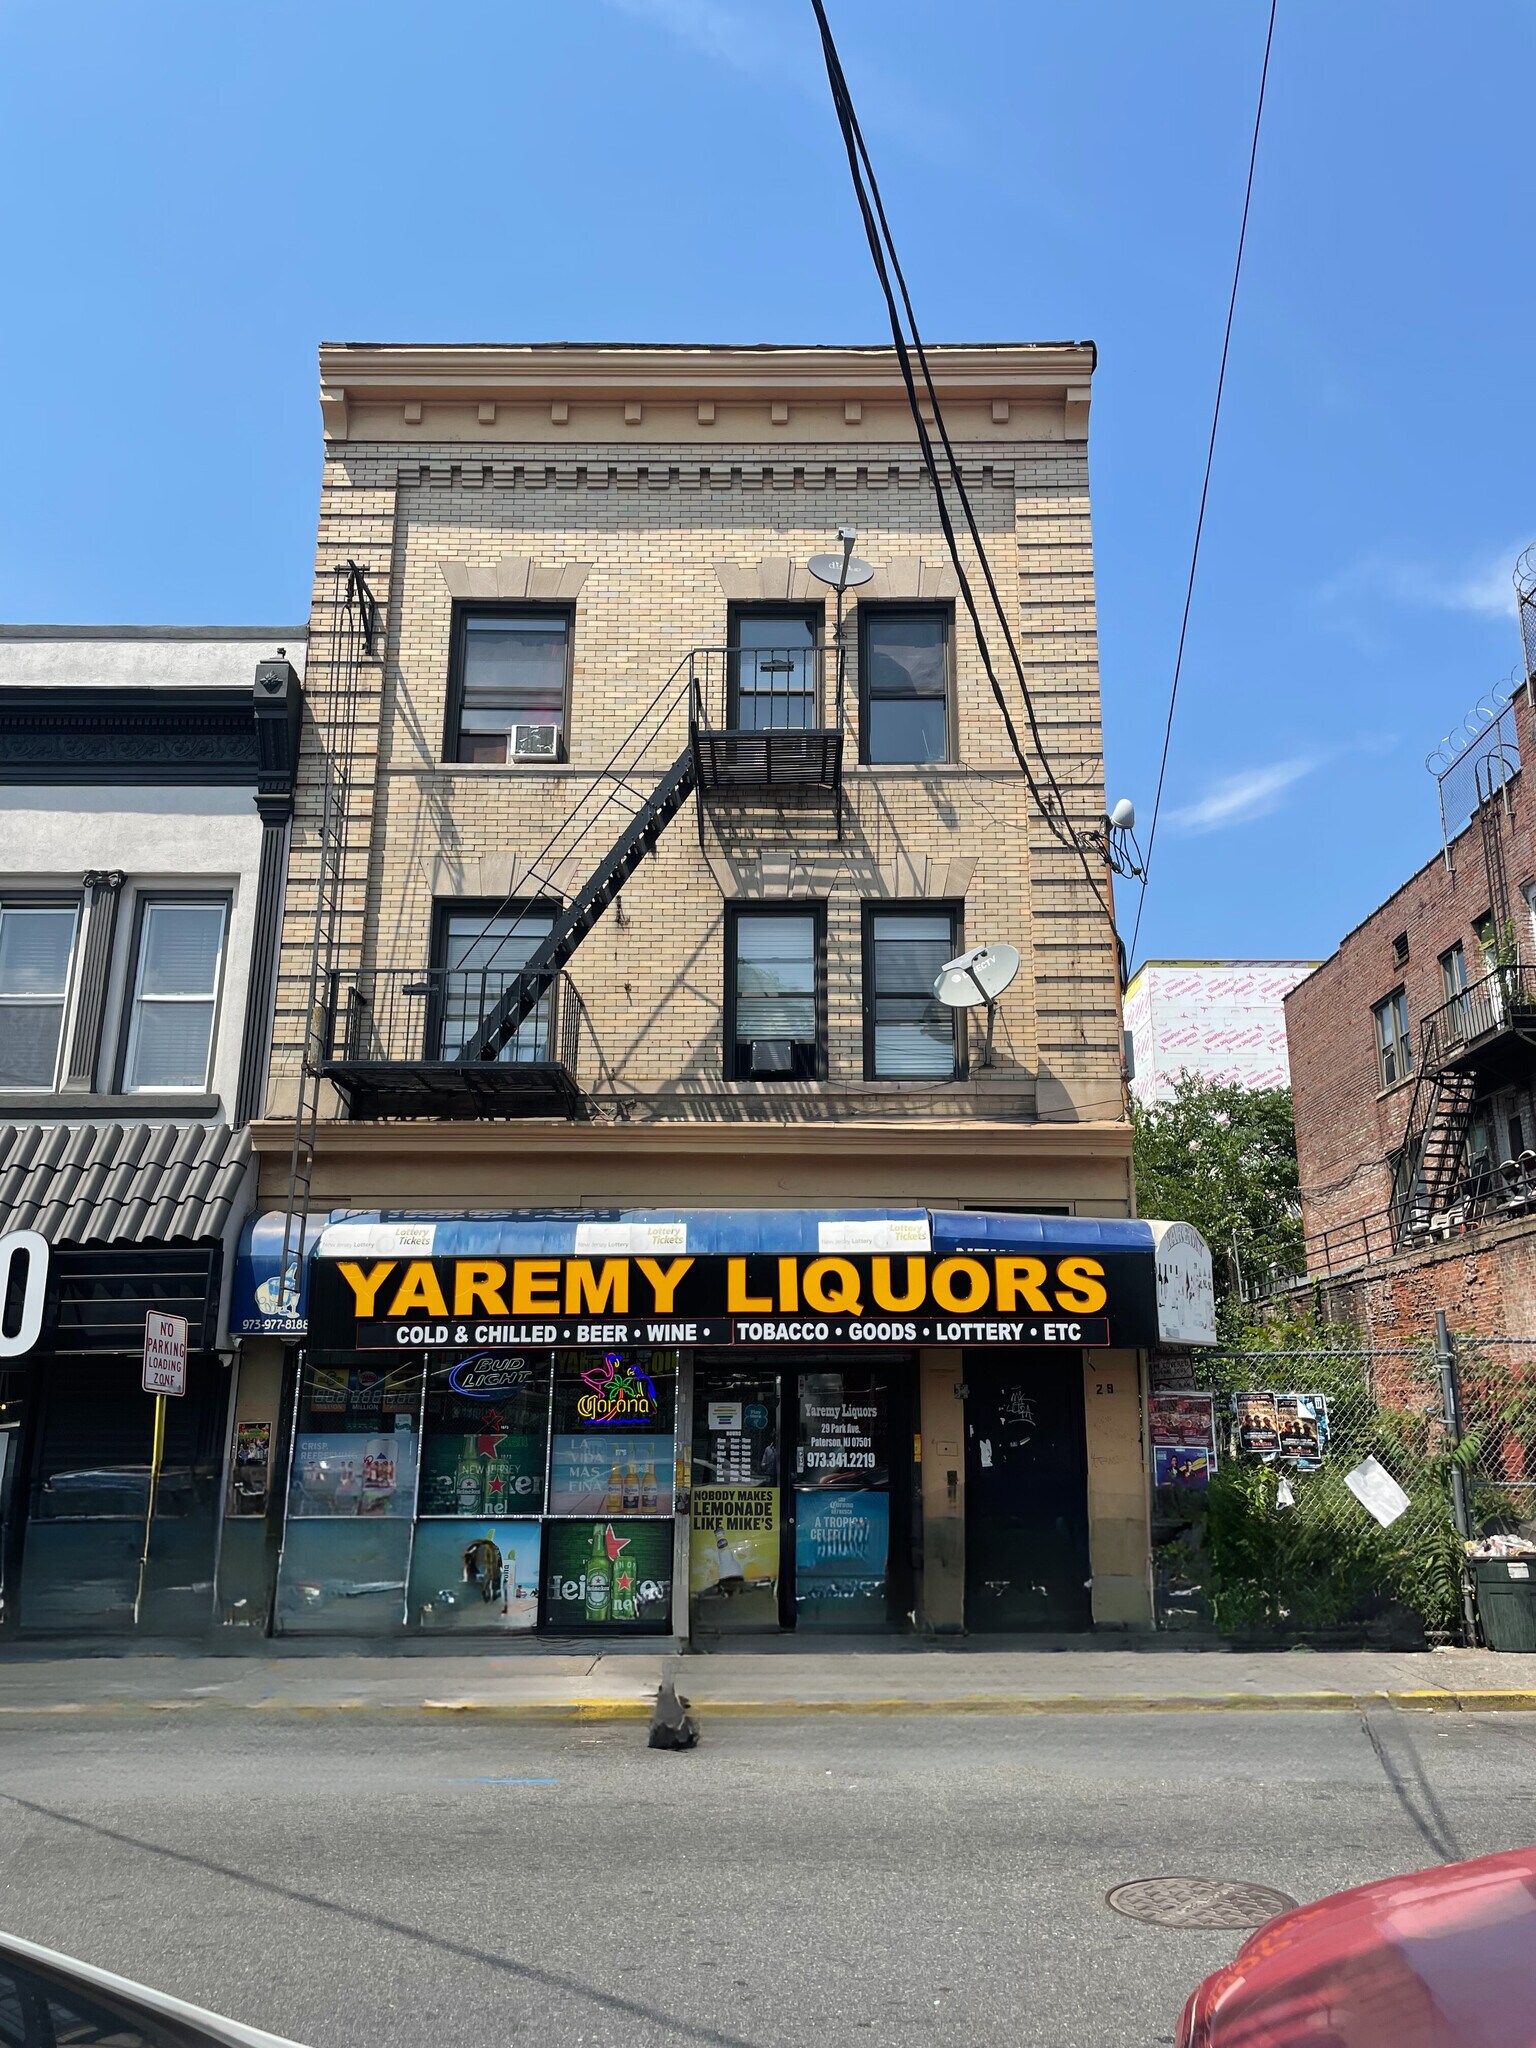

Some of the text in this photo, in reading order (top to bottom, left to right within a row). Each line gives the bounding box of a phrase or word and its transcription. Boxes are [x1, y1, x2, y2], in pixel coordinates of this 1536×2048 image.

[962, 955, 996, 980] DECTV
[396, 1228, 428, 1237] Lottery
[648, 1228, 680, 1236] Lottery
[890, 1224, 922, 1234] Lottery
[896, 1232, 926, 1240] Tickets
[399, 1236, 430, 1245] Tickets
[652, 1236, 683, 1244] Tickets
[335, 1257, 696, 1317] YAREMY
[727, 1255, 1108, 1317] LIQUORS
[160, 1321, 174, 1338] NO
[396, 1323, 697, 1344] COLD & CHILLED BEER WINE
[737, 1323, 1082, 1341] TOBACCO GOODS LOTTERY ETC
[147, 1337, 185, 1358] PARKING
[149, 1356, 182, 1373] LOADING
[474, 1357, 526, 1373] BUD
[153, 1372, 175, 1386] ZONE
[461, 1371, 533, 1388] LIGHT
[1096, 1383, 1114, 1395] 29
[577, 1394, 649, 1420] Corona
[804, 1403, 878, 1420] Yaremy Liquors
[821, 1423, 861, 1434] 29 Park Ave.
[811, 1436, 872, 1448] Paterson, NJ 07501
[807, 1452, 876, 1468] 973.341.2219
[694, 1490, 773, 1501] NOBODY MAKES
[694, 1502, 772, 1516] LEMONADE
[830, 1501, 854, 1509] Corona
[694, 1517, 773, 1531] LIKE MIKE'S
[814, 1516, 822, 1528] A
